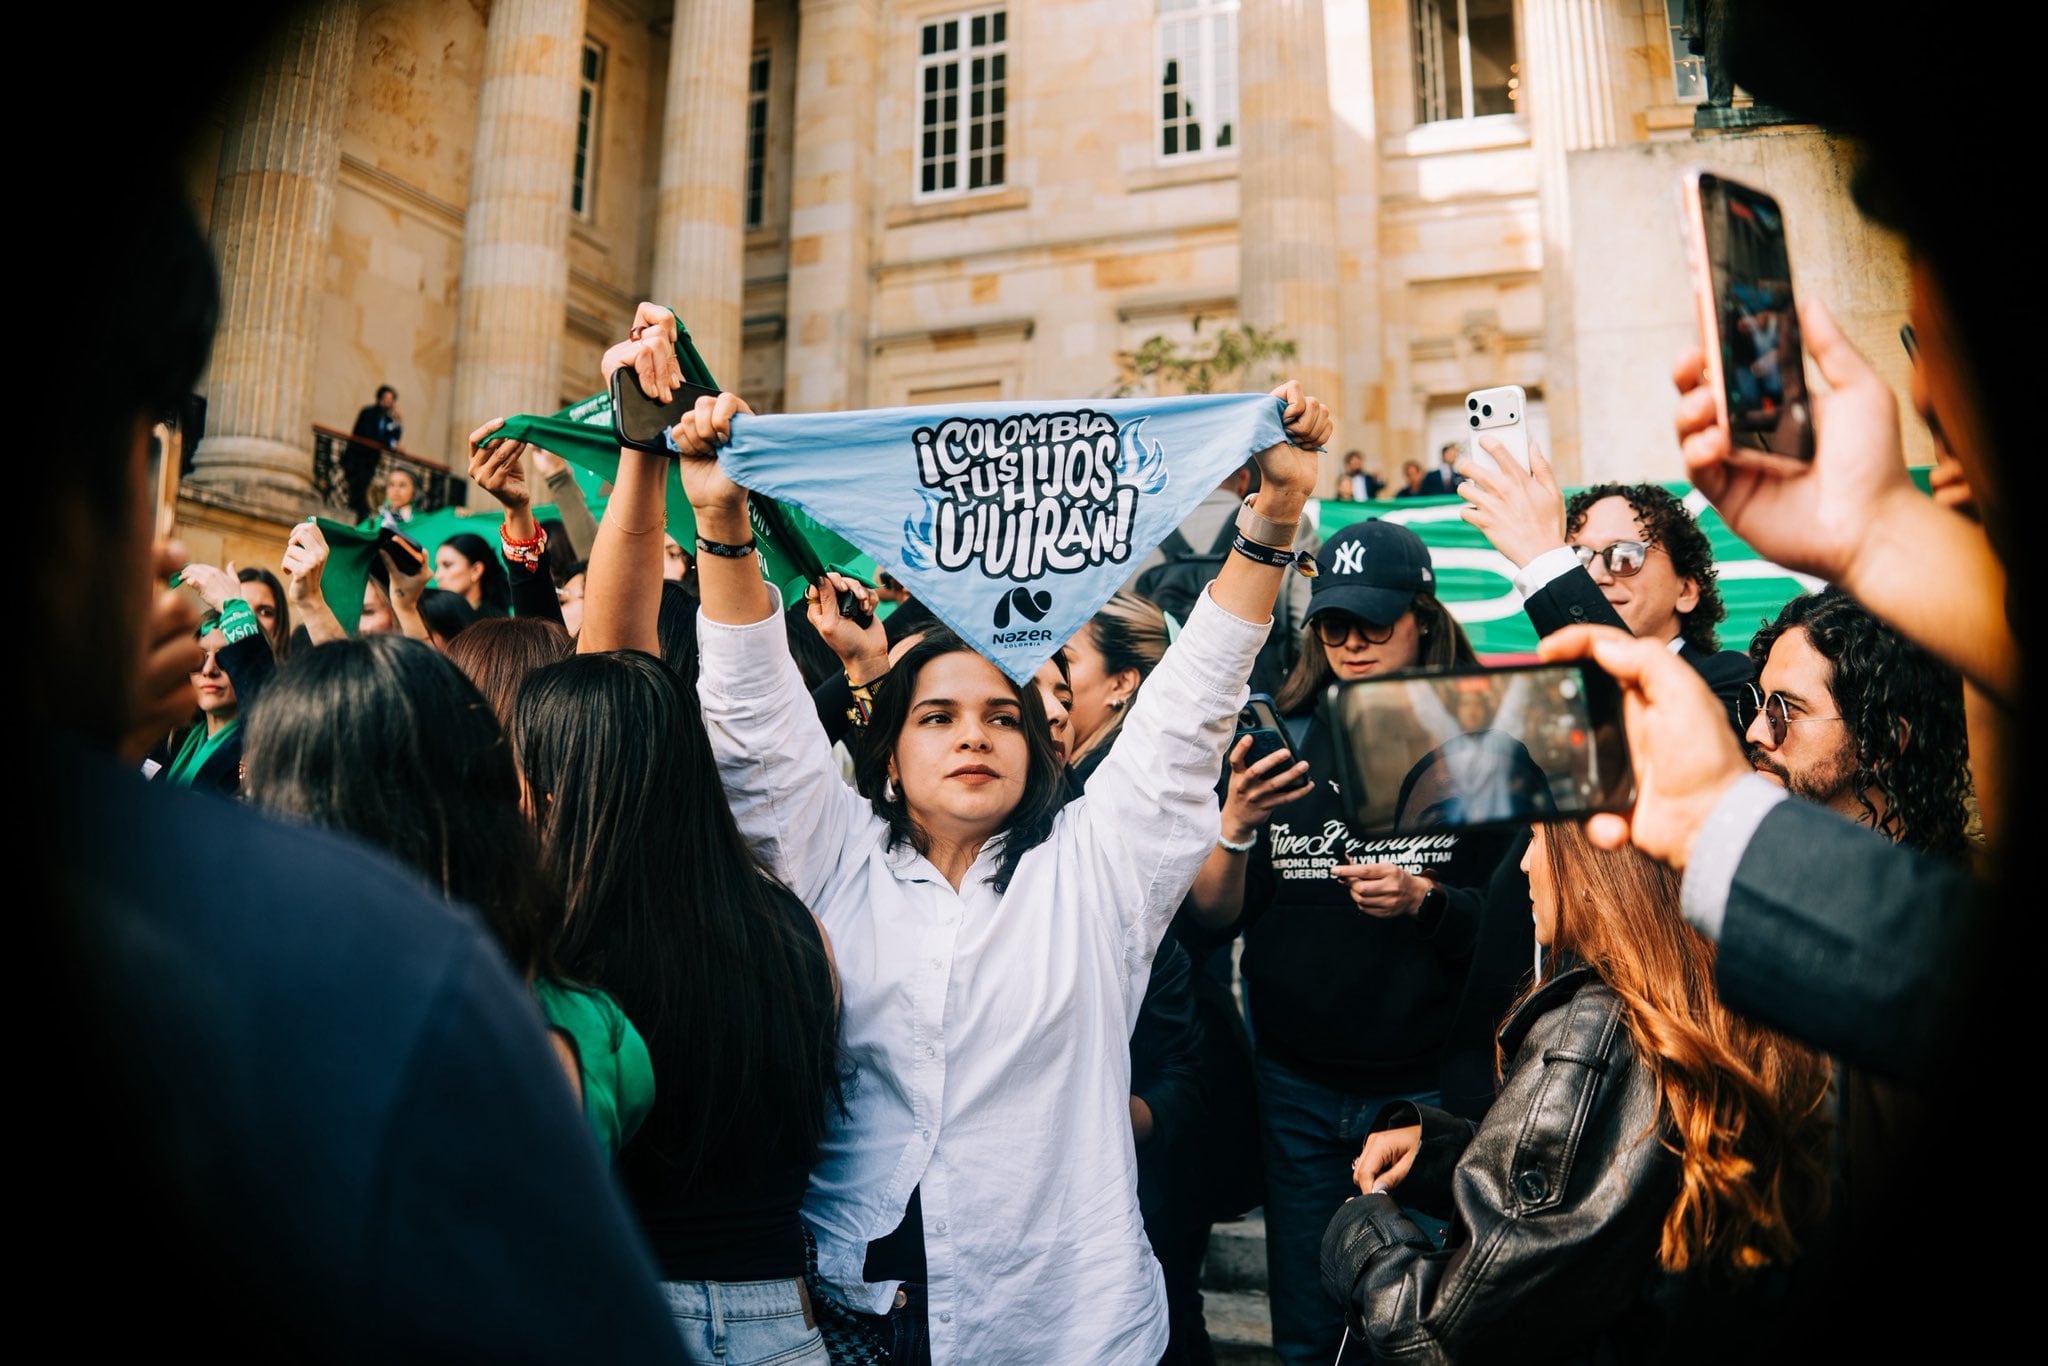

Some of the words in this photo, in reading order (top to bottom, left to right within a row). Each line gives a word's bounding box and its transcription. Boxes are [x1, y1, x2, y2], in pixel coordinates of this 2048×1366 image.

[914, 411, 1117, 487] ¡COLOMBIA
[944, 451, 1018, 502] TUS
[1003, 433, 1117, 511] HIJOS
[938, 486, 1136, 580] VIVIRÁN!
[1332, 540, 1366, 574] NY
[226, 623, 259, 643] AUSA
[1283, 869, 1329, 879] QUEENS
